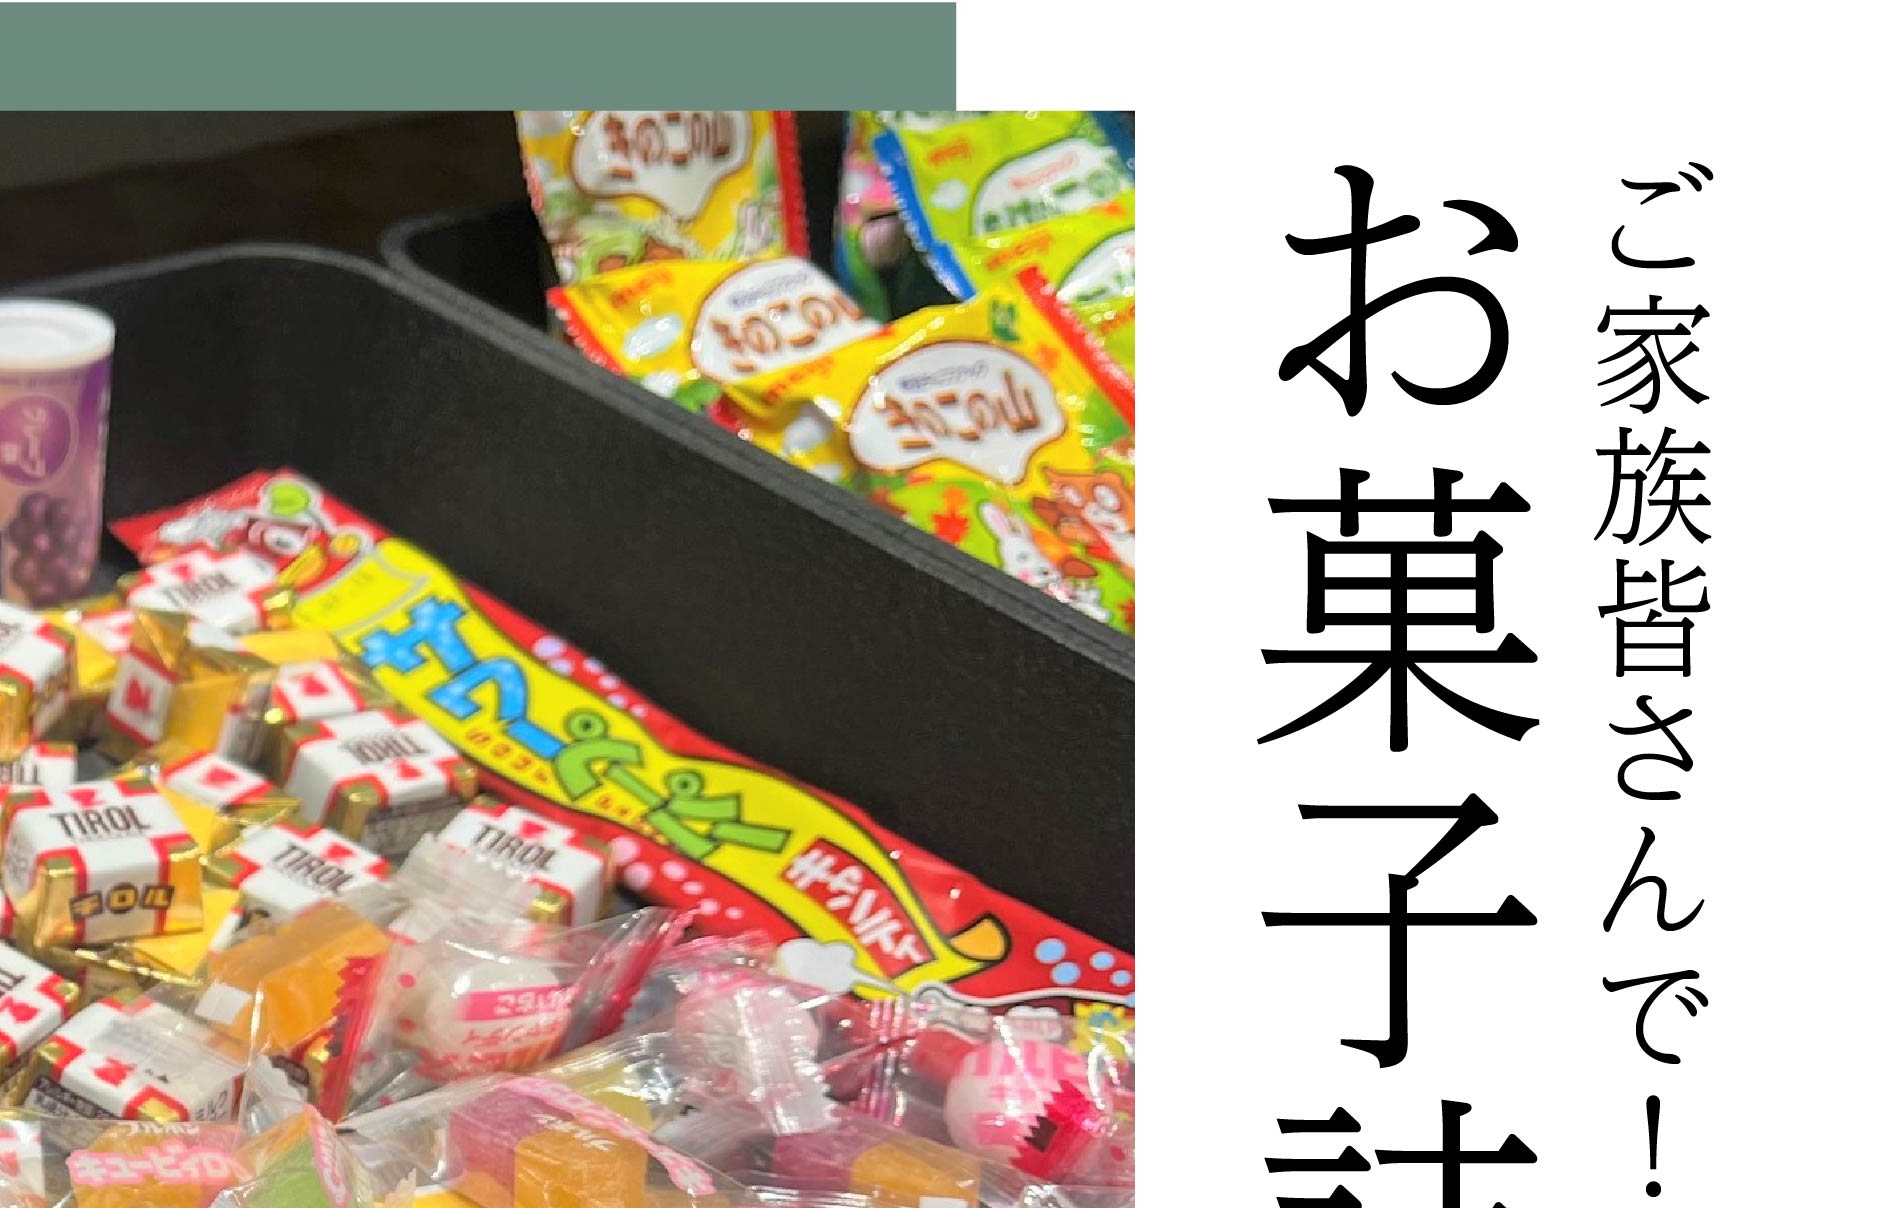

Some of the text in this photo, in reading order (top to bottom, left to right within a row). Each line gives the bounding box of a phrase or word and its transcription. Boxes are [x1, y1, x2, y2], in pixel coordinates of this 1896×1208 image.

[49, 805, 151, 839] TIROL
[270, 844, 357, 894] TIROL
[472, 826, 559, 873] TIROL
[70, 883, 175, 919] チロル
